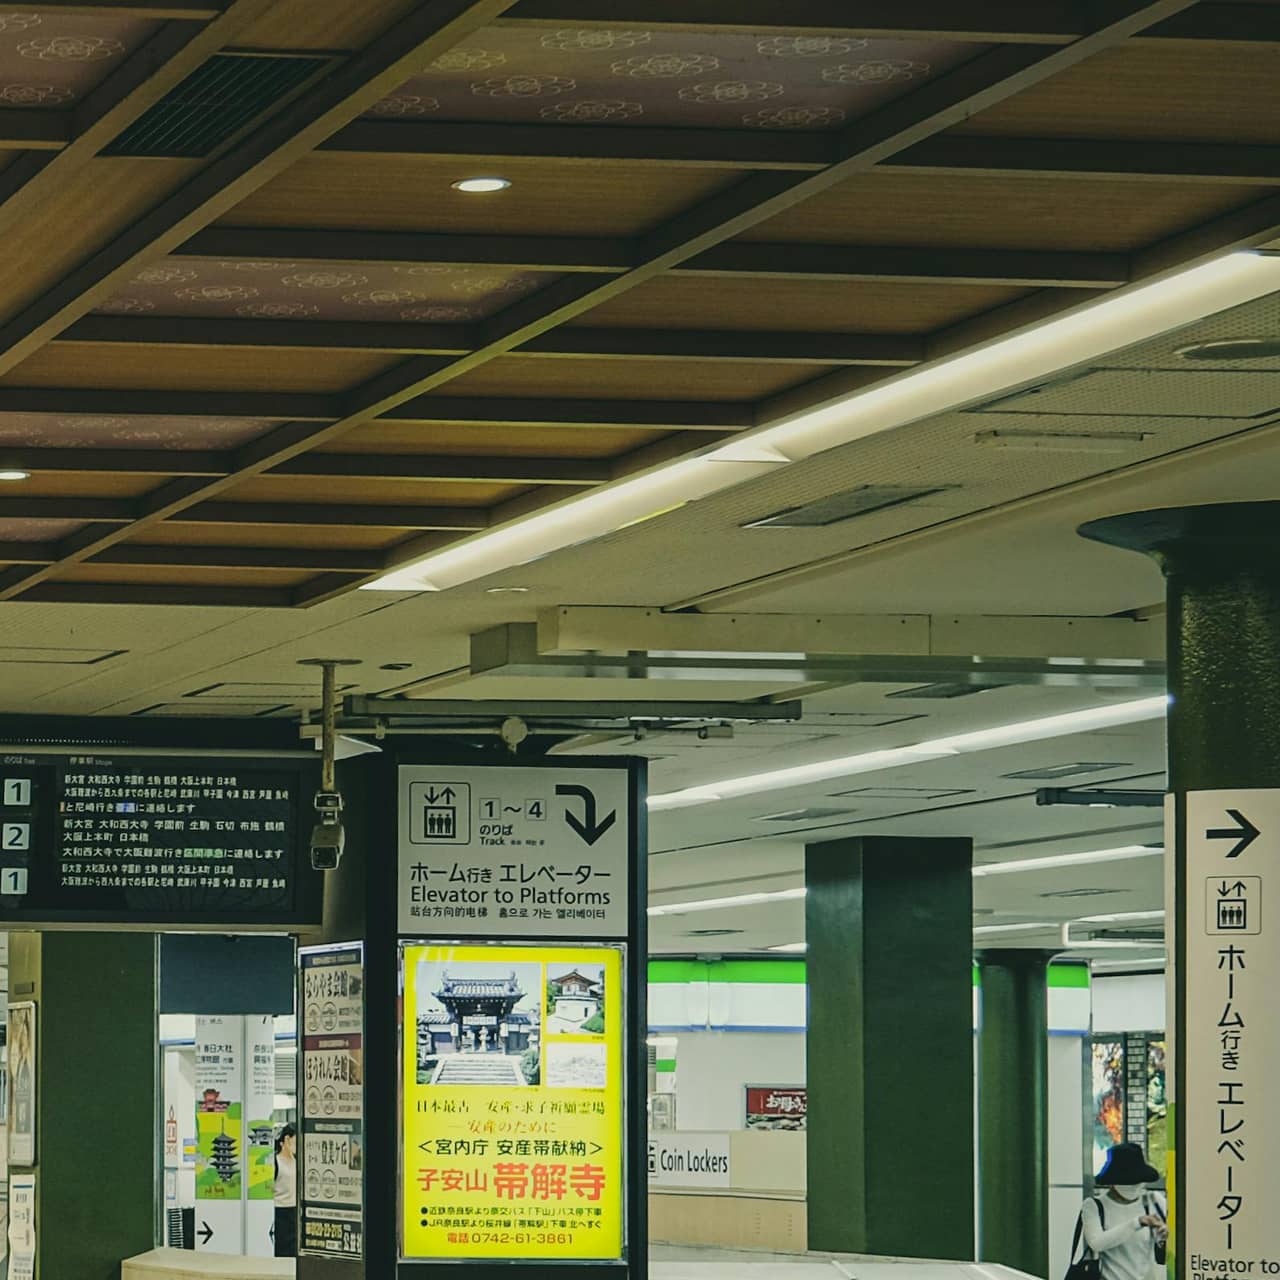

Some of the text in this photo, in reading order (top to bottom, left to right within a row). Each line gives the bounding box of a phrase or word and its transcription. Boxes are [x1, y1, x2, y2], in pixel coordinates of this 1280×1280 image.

[11, 783, 22, 802] 1
[8, 827, 23, 846] 2
[480, 824, 512, 835] のりば
[480, 837, 505, 845] Track
[8, 872, 19, 891] 1
[410, 862, 610, 884] ホーム行き エレベーター
[412, 886, 610, 904] Elevator to Platforms
[533, 908, 552, 919] 가는
[557, 908, 605, 919] 엘리베이터
[1217, 945, 1245, 1070] ホーム行き
[418, 1100, 469, 1113] 日本最古
[468, 1120, 557, 1134] 安産のために
[661, 1149, 727, 1172] Coin Lockers
[1216, 1083, 1245, 1249] エレベーター
[417, 1163, 605, 1200] 子安山 帯解寺
[448, 1233, 573, 1244] 電話 0742-61-3861
[1191, 1254, 1280, 1274] Elevator to
